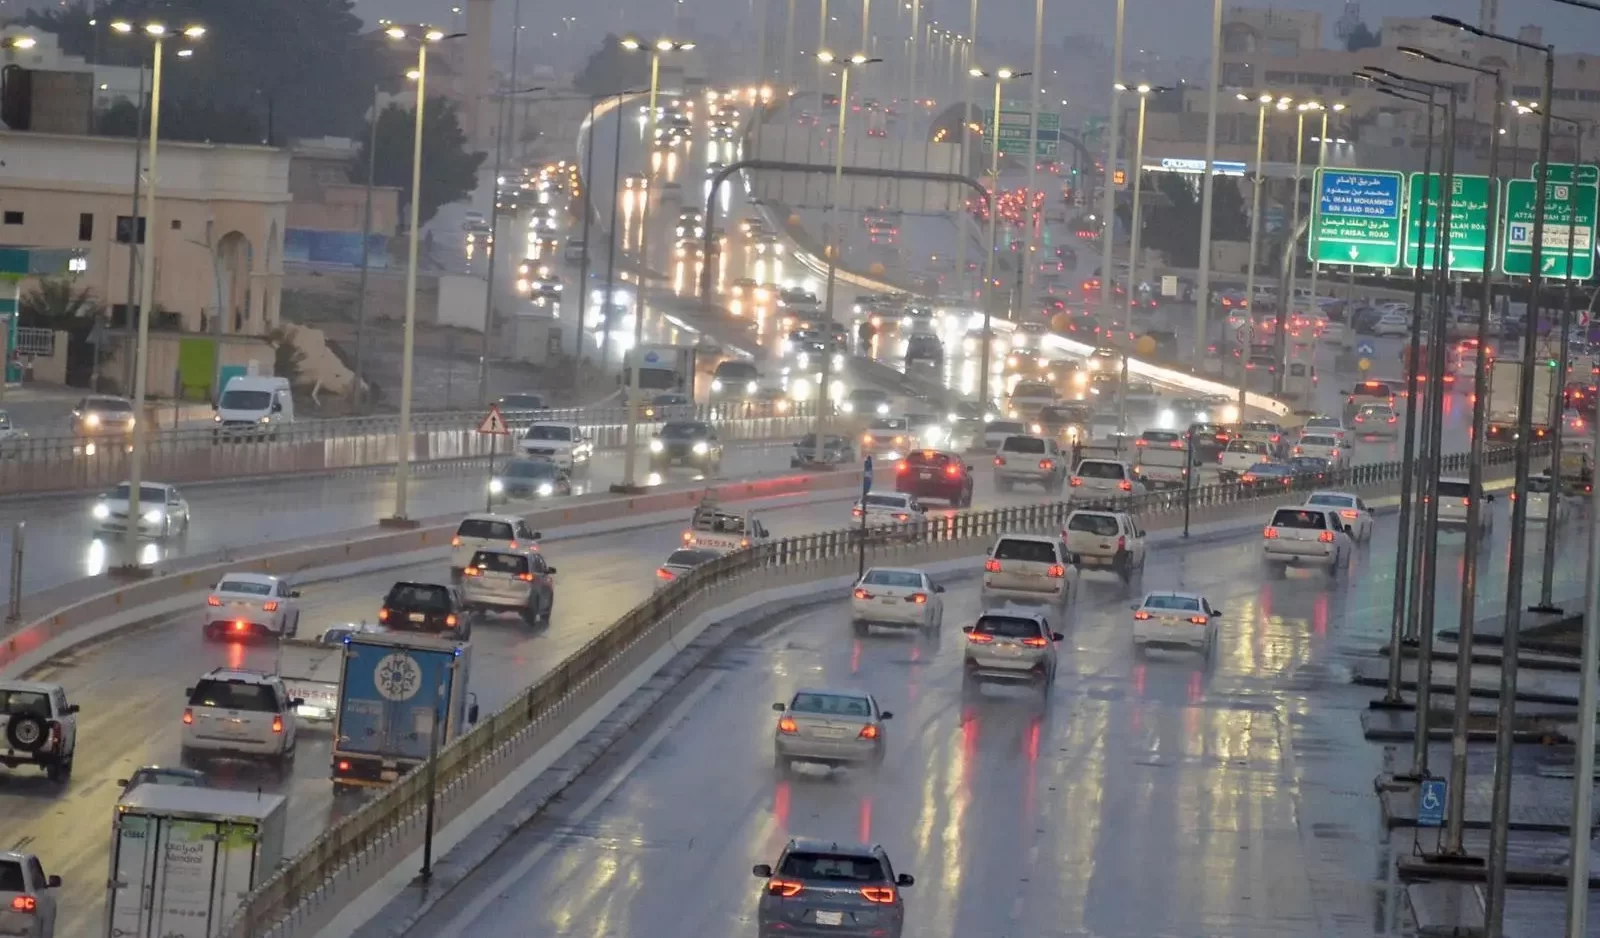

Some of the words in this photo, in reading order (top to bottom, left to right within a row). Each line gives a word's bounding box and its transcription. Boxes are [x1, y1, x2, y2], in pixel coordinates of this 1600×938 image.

[1360, 178, 1381, 186] طريق
[1343, 205, 1363, 213] SAUD
[1364, 206, 1385, 214] ROAD
[1368, 220, 1389, 229] طريق
[1321, 228, 1338, 236] KING
[1340, 229, 1366, 237] FAISAL
[1368, 230, 1389, 238] ROAD
[695, 538, 736, 548] NISSAN
